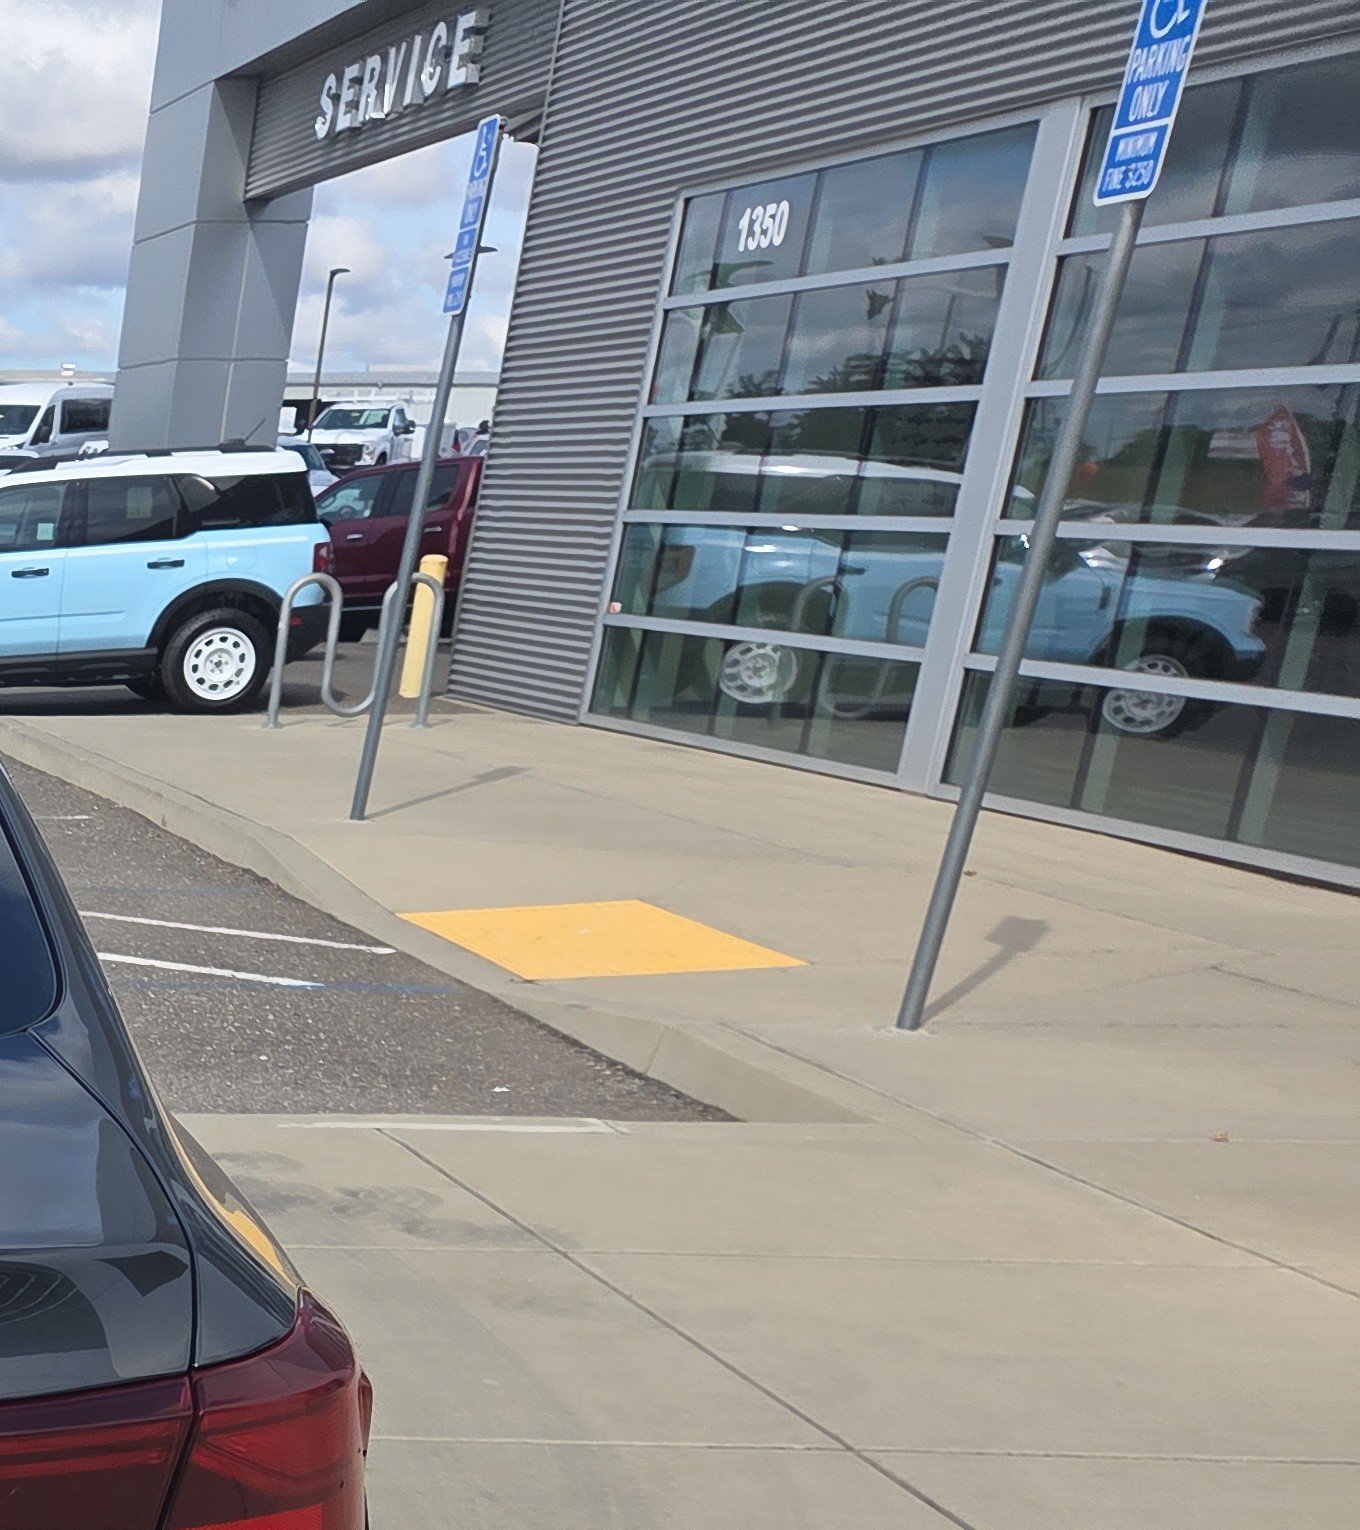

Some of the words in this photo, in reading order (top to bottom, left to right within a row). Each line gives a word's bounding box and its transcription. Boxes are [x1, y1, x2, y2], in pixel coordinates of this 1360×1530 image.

[315, 11, 479, 140] SERVICE
[1128, 34, 1191, 84] PARKING
[1129, 80, 1169, 121] ONLY
[738, 200, 789, 252] 1350
